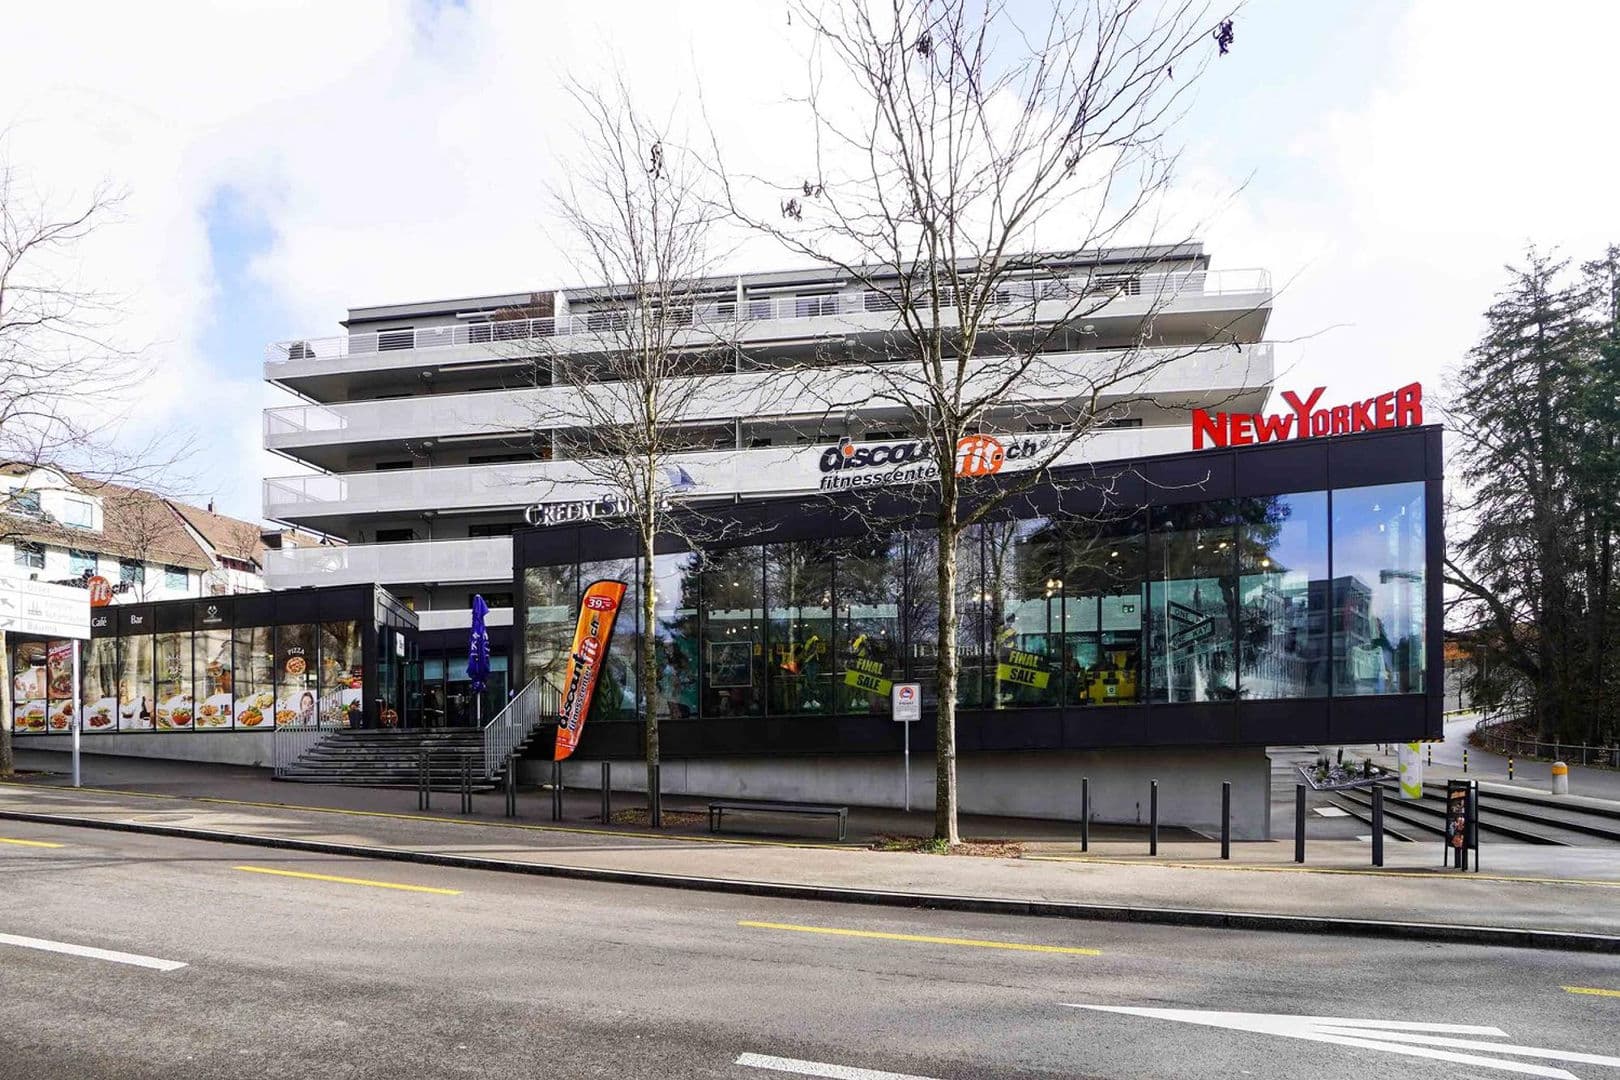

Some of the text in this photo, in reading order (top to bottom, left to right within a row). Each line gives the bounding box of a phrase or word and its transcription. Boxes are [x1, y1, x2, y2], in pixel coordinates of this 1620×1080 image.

[1192, 381, 1423, 450] NEW YORKER
[820, 465, 942, 490] fitnesscente
[525, 500, 603, 526] CREDIT
[92, 616, 107, 627] Café
[130, 614, 143, 625] Bar
[856, 658, 883, 675] FINAL
[1009, 650, 1040, 667] FINAL
[856, 674, 882, 691] SALE
[1010, 667, 1036, 684] SALE
